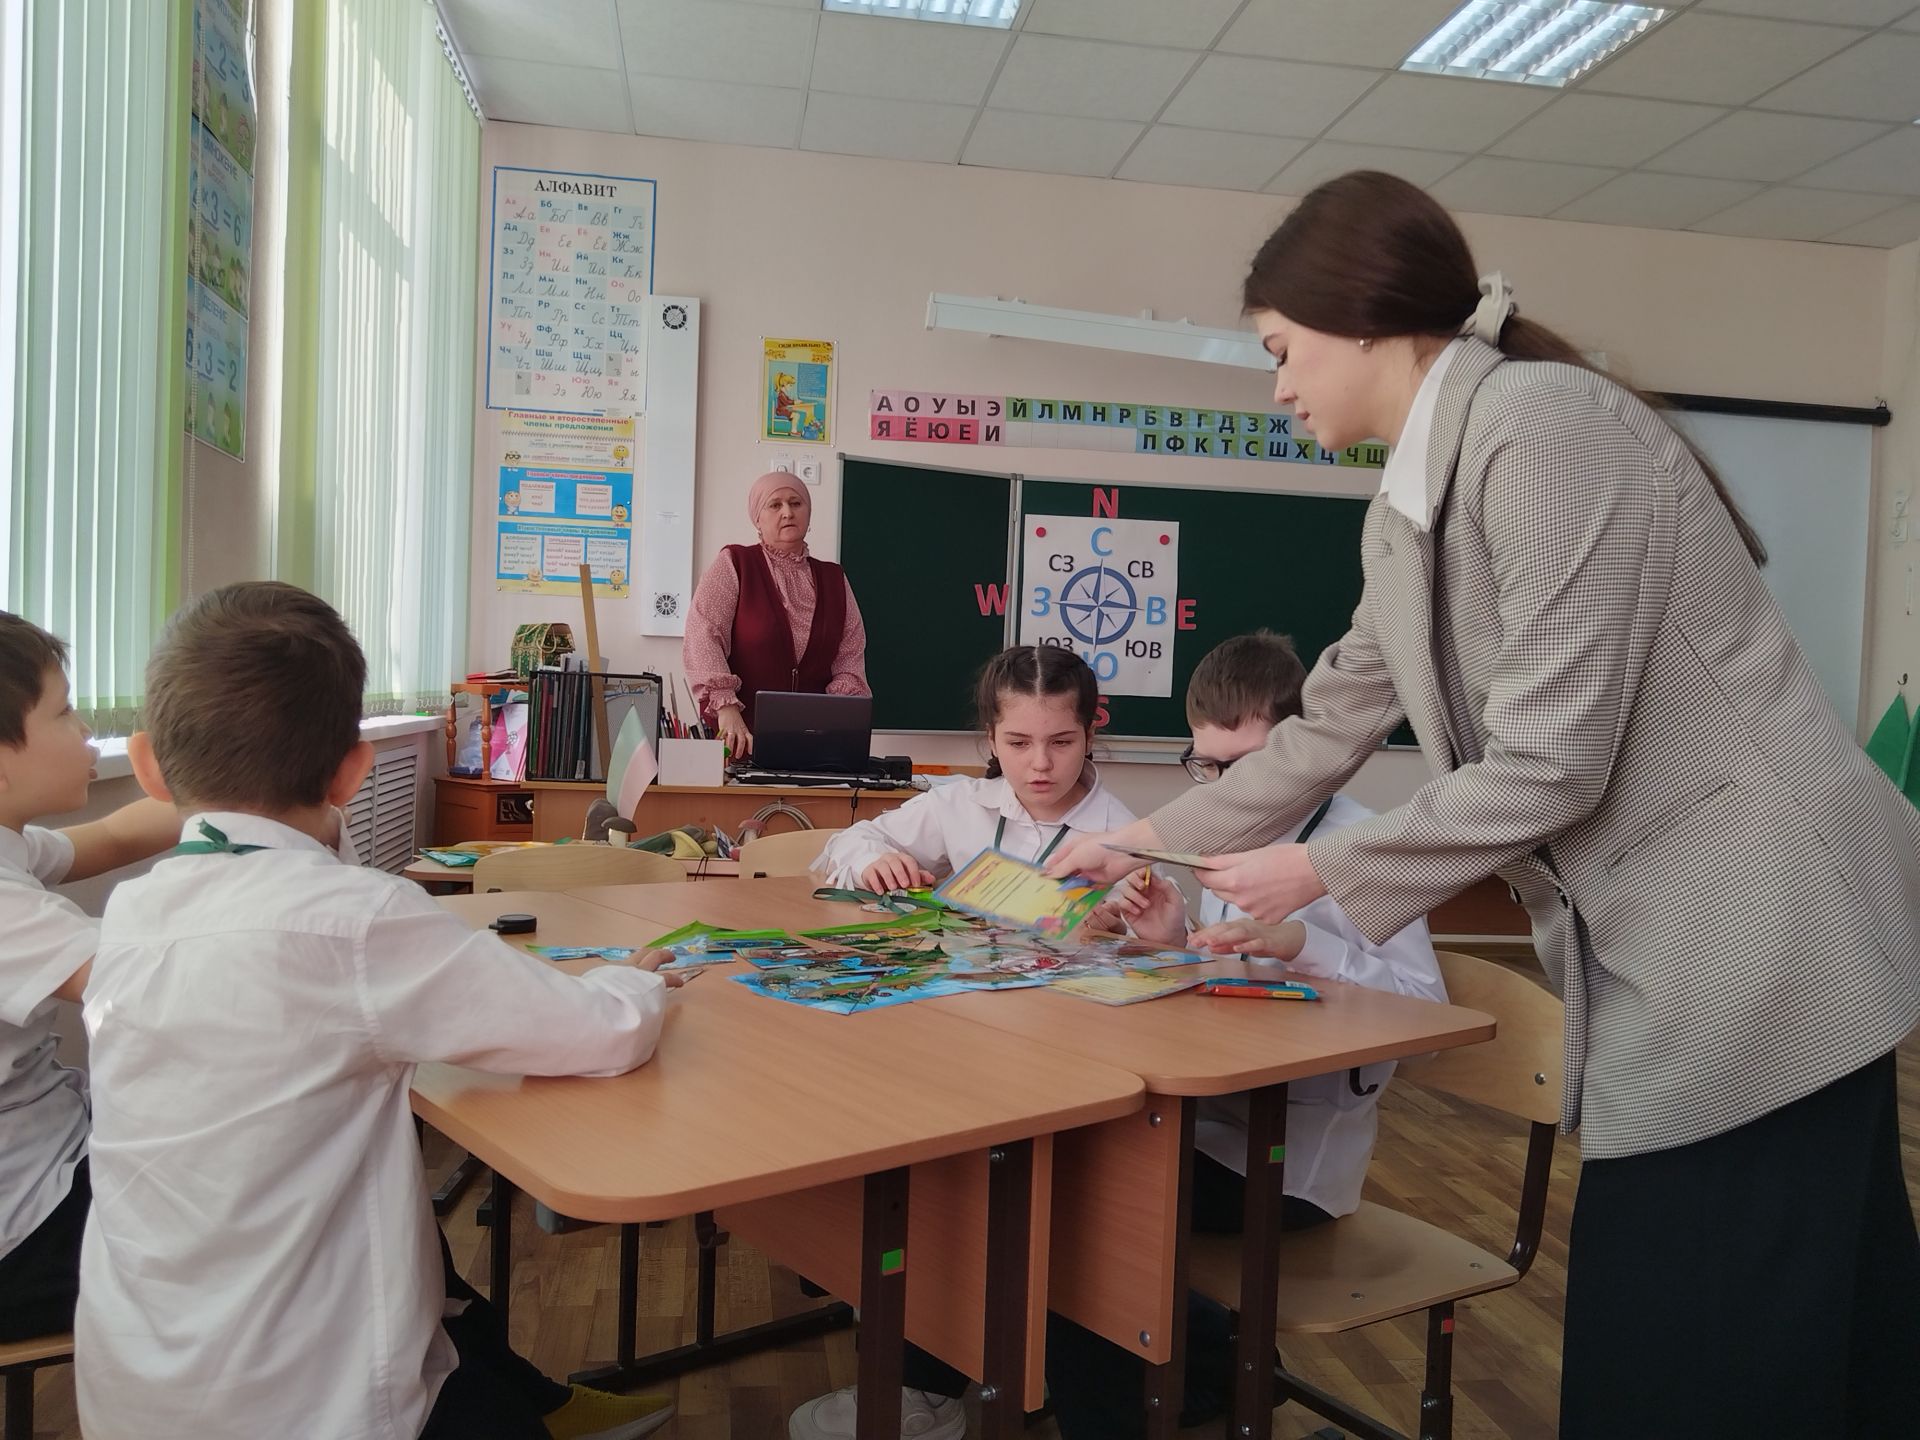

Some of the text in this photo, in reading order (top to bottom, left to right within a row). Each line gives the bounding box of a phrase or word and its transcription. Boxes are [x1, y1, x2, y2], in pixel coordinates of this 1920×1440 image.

[534, 179, 617, 198] АЛФАВИТ
[540, 200, 552, 208] Бб
[614, 206, 622, 214] Гг
[549, 208, 573, 223] Бб
[590, 211, 609, 226] Вв
[503, 222, 518, 232] Дд
[612, 231, 630, 239] Жж
[516, 231, 535, 252] Дд
[612, 239, 643, 254] Жж
[612, 256, 624, 264] Кк
[539, 275, 554, 283] Мм
[575, 277, 588, 285] Нн
[611, 280, 624, 288] Оо
[501, 297, 514, 305] Пп
[538, 300, 550, 309] Рр
[574, 302, 586, 310] Сс
[584, 286, 606, 300] Нн
[627, 289, 641, 303] Оо
[510, 305, 640, 327] Пп Рр Сс Тт
[536, 324, 553, 334] Фф
[609, 330, 623, 339] Цц
[548, 333, 568, 352] Фф
[582, 336, 604, 350] Хх
[620, 339, 639, 355] Цц
[535, 349, 553, 357] Шш
[572, 352, 591, 361] Щщ
[540, 358, 567, 371] Шш
[576, 360, 602, 376] Щщ
[535, 373, 546, 381] Ээ
[553, 383, 567, 397] Ээ
[581, 385, 602, 399] Юю
[618, 388, 637, 400] Яя
[508, 411, 547, 420] Главные
[557, 414, 629, 425] второстепенные
[554, 423, 614, 432] предложения
[1092, 488, 1119, 519] N
[1090, 527, 1113, 556] С
[1049, 554, 1154, 578] СЗ СВ
[974, 584, 1009, 616] W
[1031, 587, 1167, 625] З В
[1177, 599, 1197, 630] E
[1125, 640, 1162, 659] ЮВ
